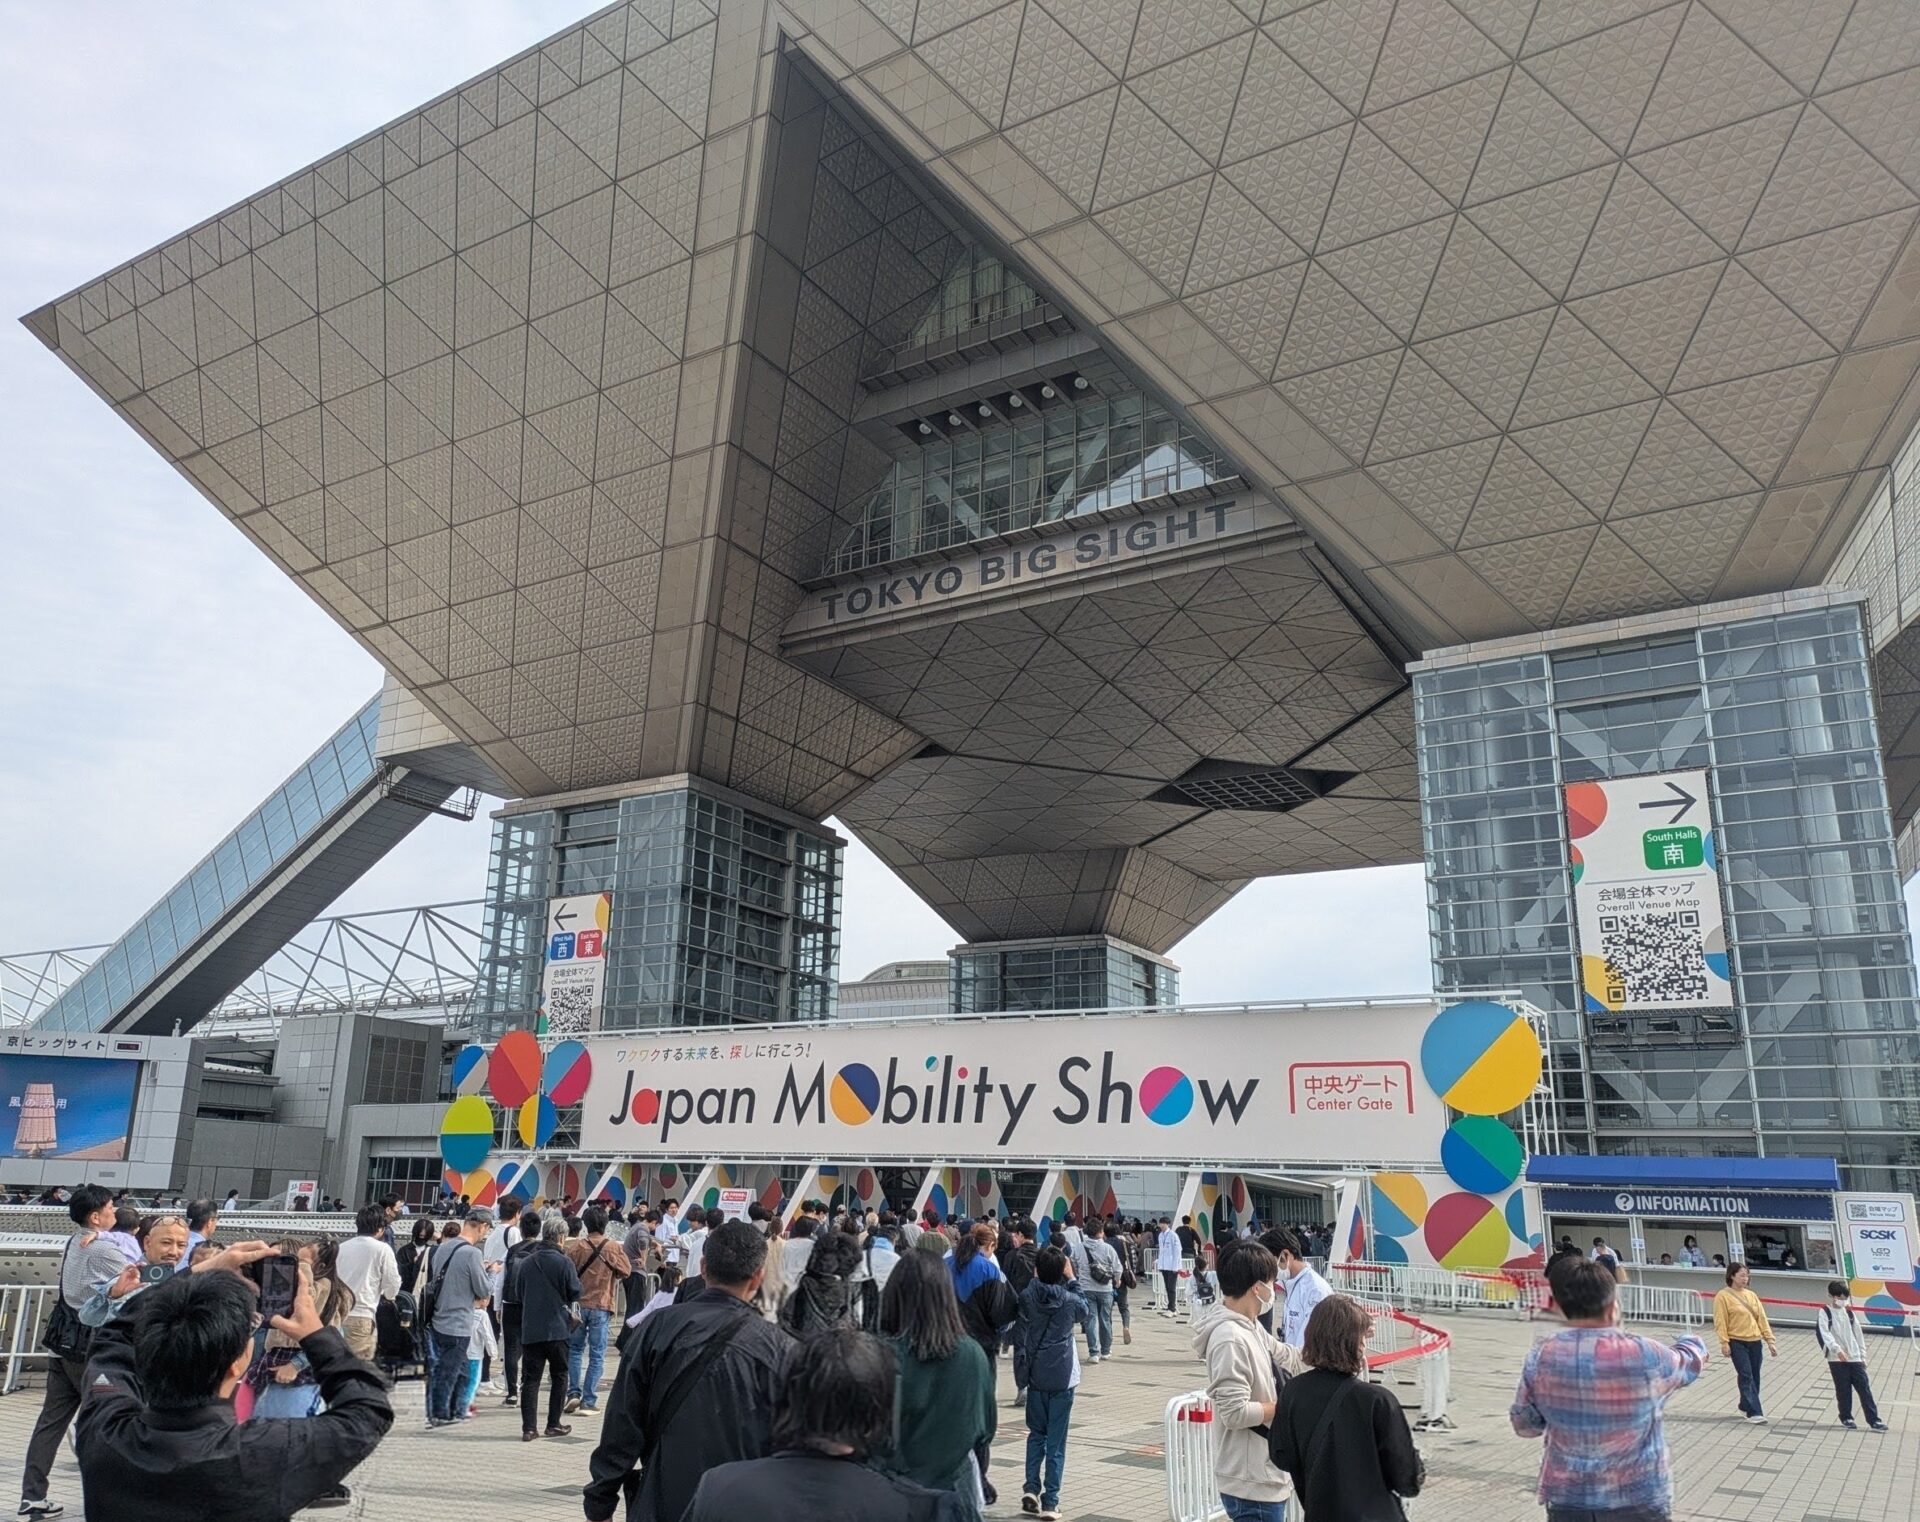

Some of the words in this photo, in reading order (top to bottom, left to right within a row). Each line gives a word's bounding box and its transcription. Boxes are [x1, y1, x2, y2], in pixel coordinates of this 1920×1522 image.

[821, 566, 963, 620] TOKYO
[981, 544, 1057, 585] BIG
[1075, 501, 1237, 564] SIGHT
[1647, 831, 1674, 842] South
[1675, 830, 1698, 840] Halls
[1663, 843, 1685, 866] 南
[1598, 881, 1696, 901] 会場全体マップ
[1597, 902, 1635, 912] Overall
[1637, 900, 1671, 910] Venue
[1675, 898, 1700, 908] Map
[558, 943, 568, 958] 西
[585, 941, 595, 955] 東
[0, 1036, 105, 1050] 京ビッグサイト
[1304, 1074, 1399, 1095] 中央ゲート
[609, 1070, 755, 1144] Japan
[773, 1054, 1037, 1146] Mobility
[1052, 1051, 1261, 1126] Show
[1306, 1096, 1352, 1111] Center
[1357, 1096, 1394, 1111] Gate
[1637, 1196, 1750, 1213] INFORMATION
[1860, 1229, 1897, 1240] SCSK
